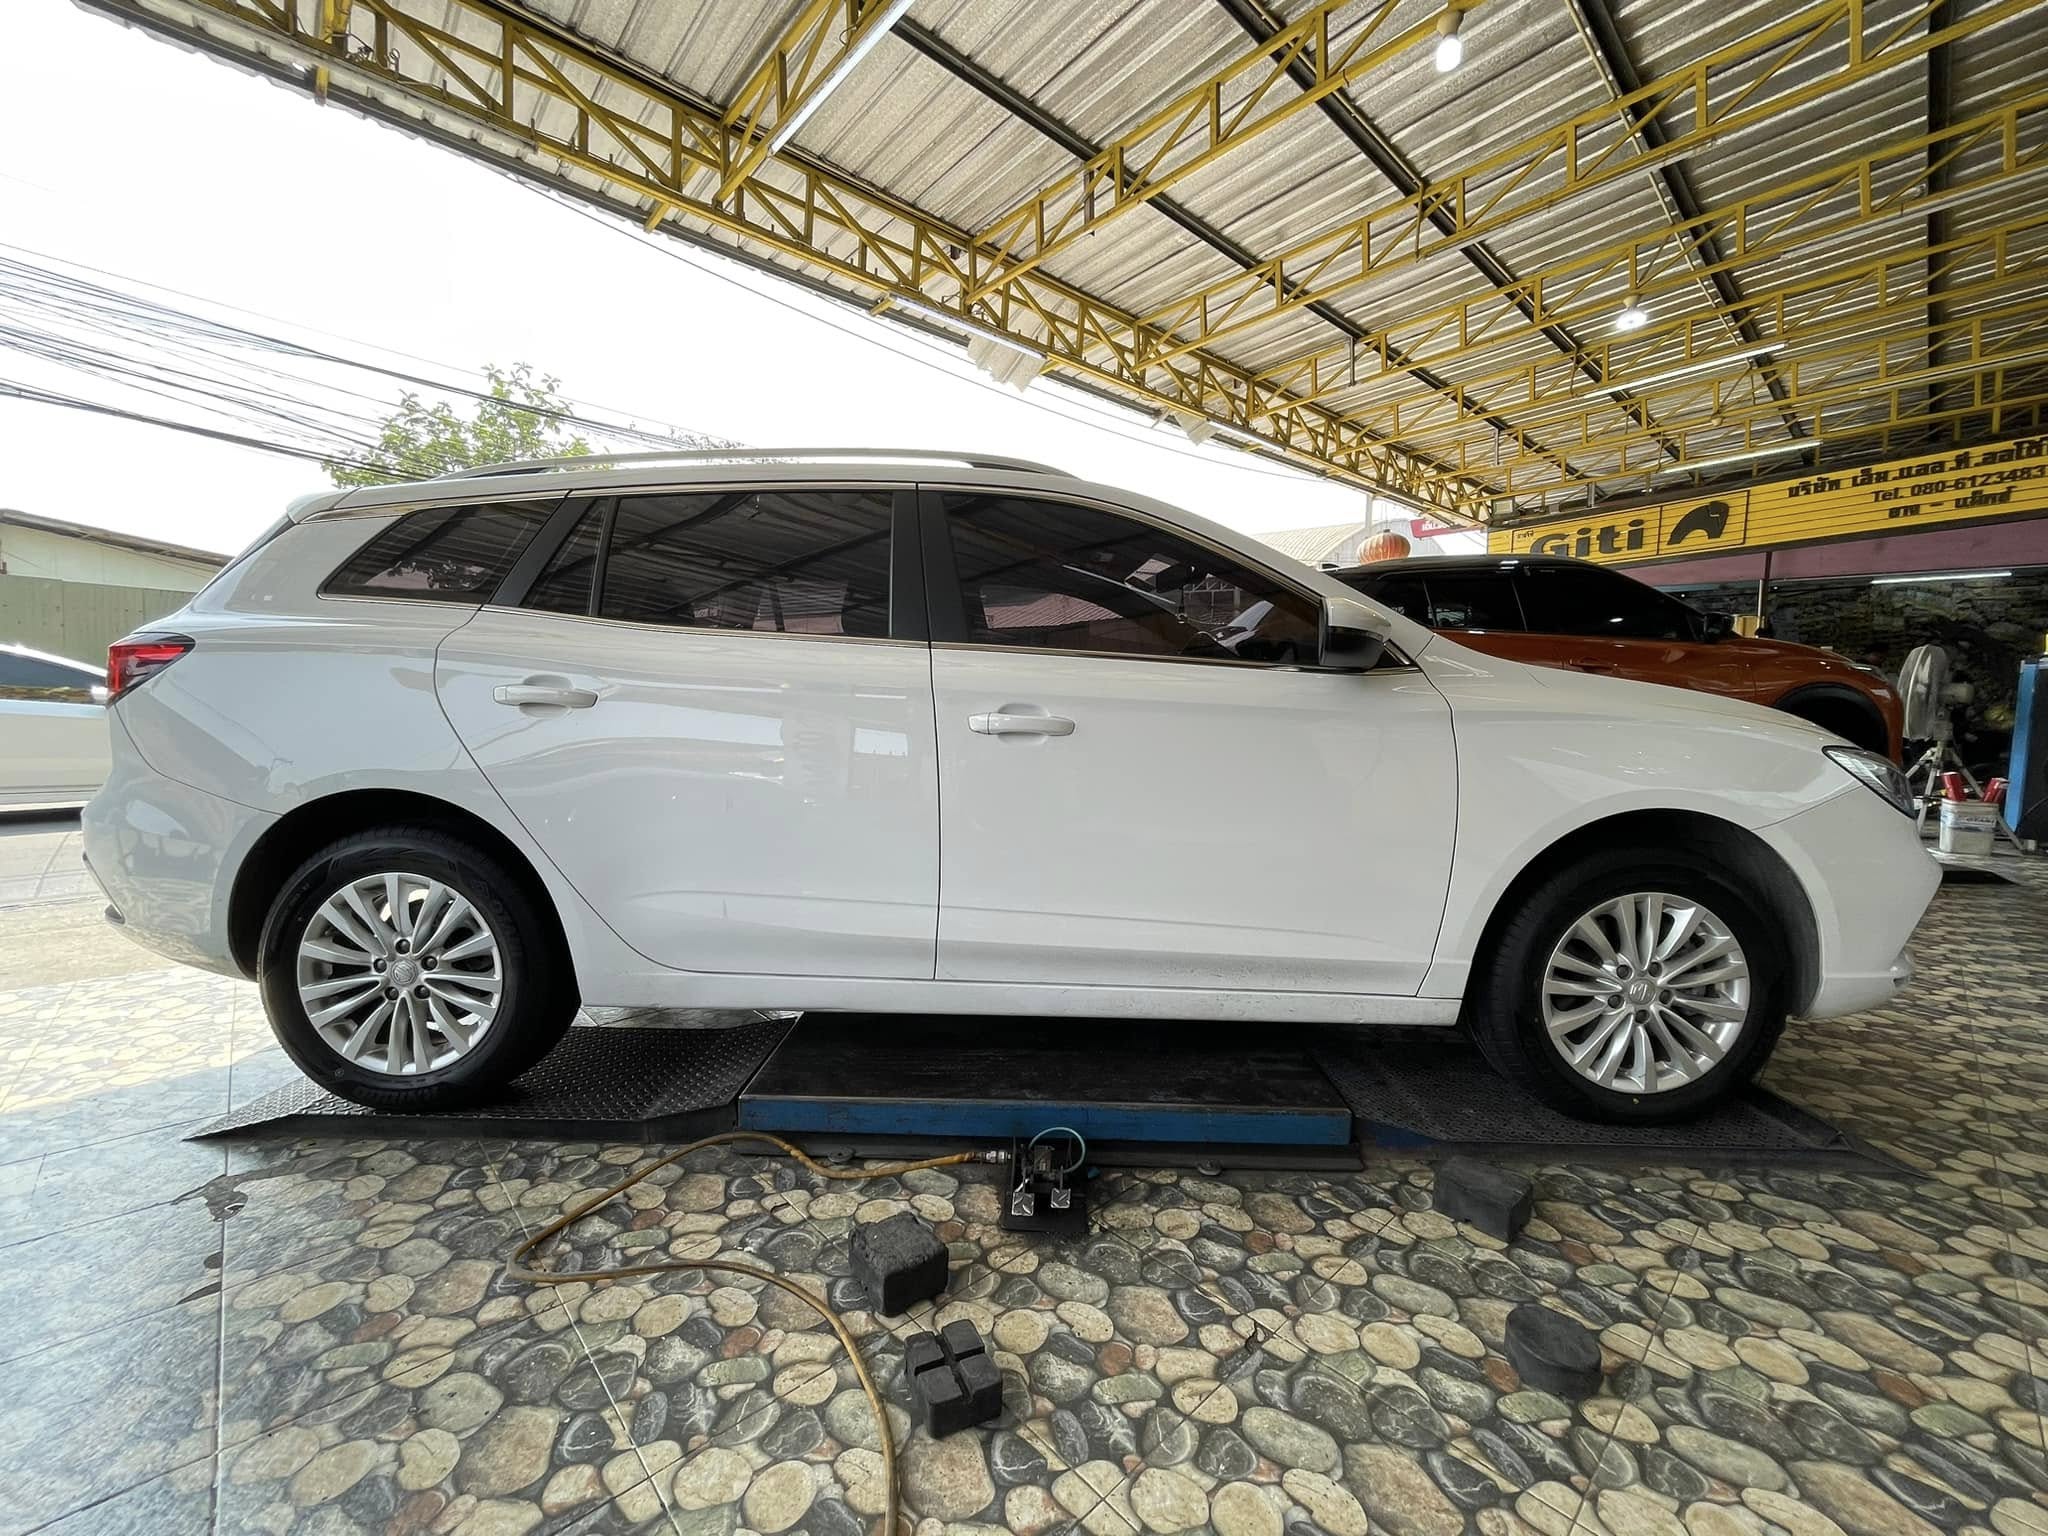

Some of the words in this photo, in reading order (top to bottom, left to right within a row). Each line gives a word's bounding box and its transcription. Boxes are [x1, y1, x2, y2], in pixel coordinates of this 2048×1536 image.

[1788, 477, 1840, 498] บริษัท
[1872, 487, 1904, 502] Tel.
[1530, 519, 1645, 558] Giti
